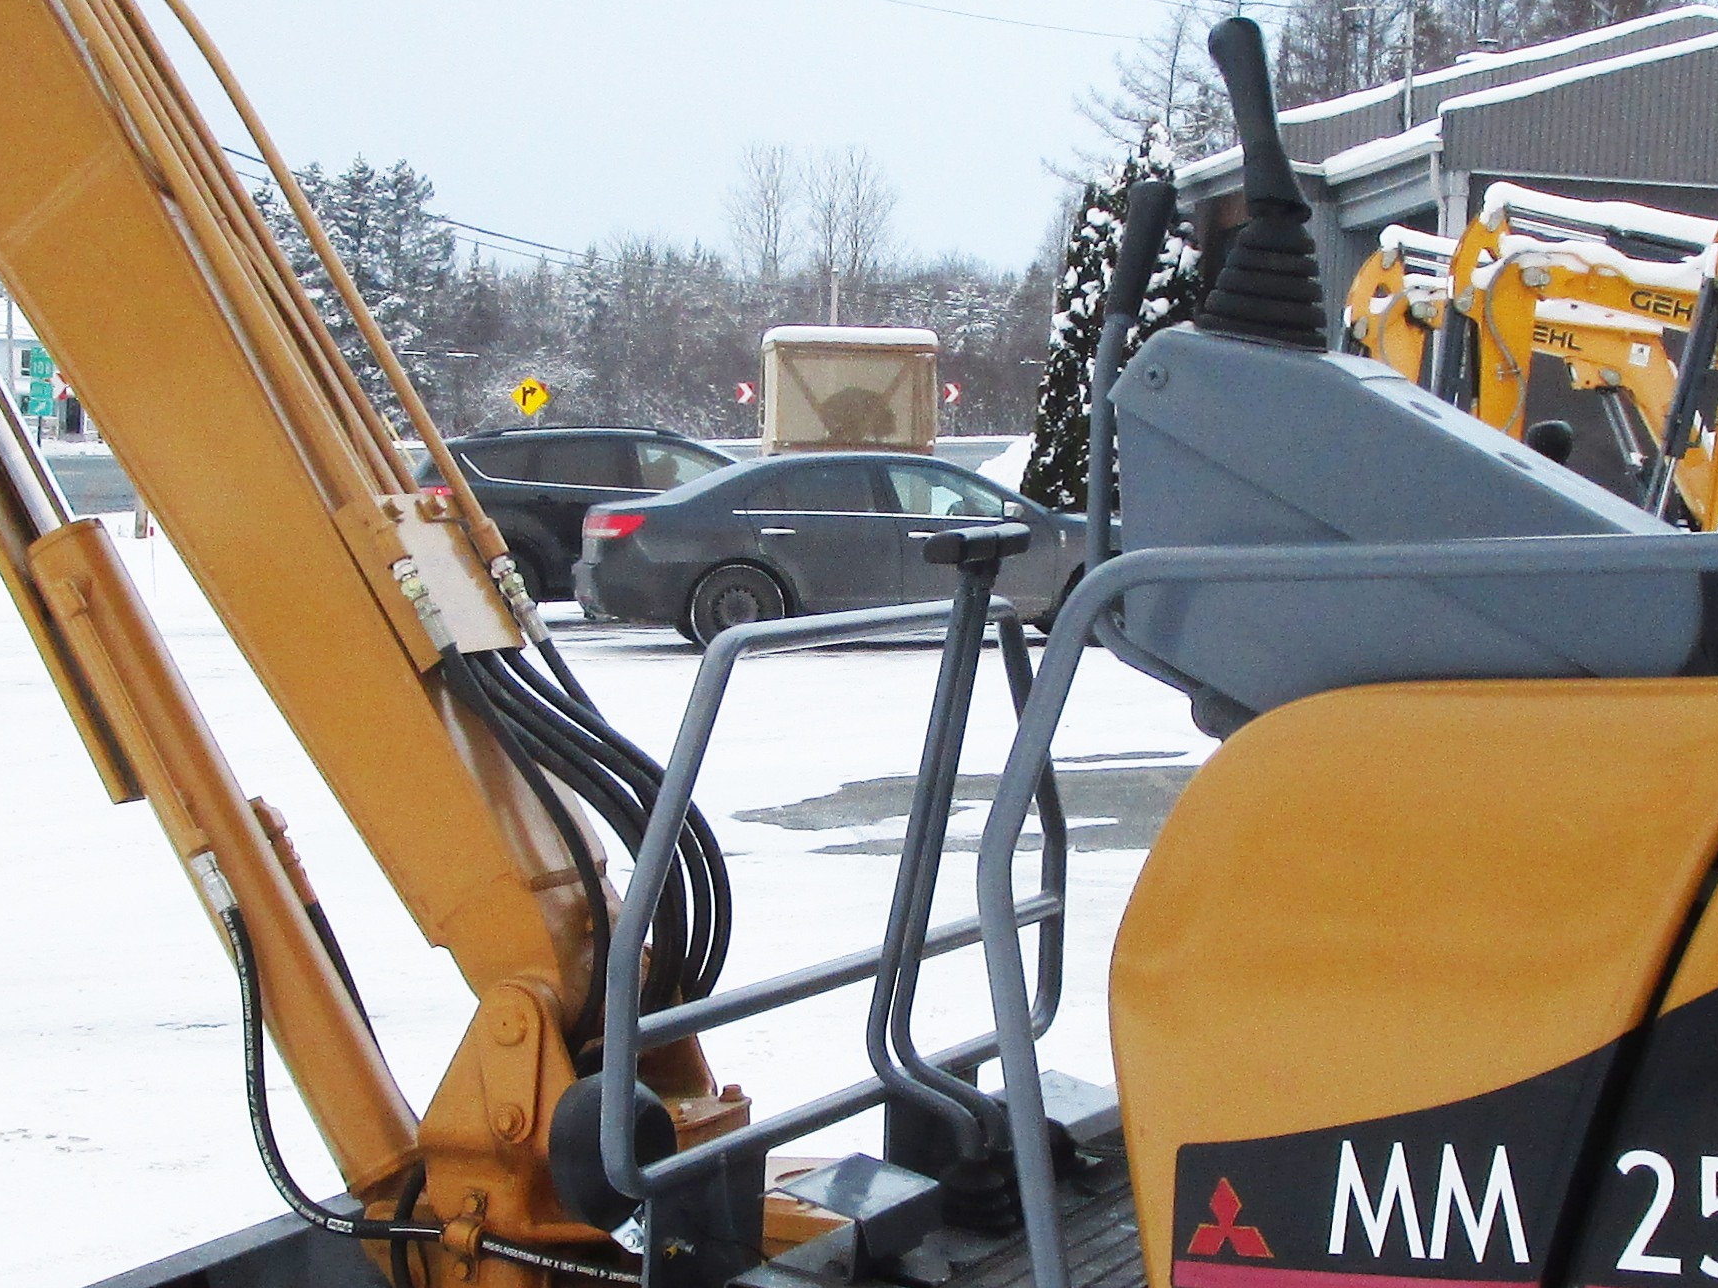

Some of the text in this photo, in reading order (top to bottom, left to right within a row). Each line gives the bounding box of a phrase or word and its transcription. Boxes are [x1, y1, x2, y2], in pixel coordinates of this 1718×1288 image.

[1630, 290, 1695, 321] GEH
[1533, 323, 1582, 351] EHL
[1328, 1140, 1530, 1263] MM
